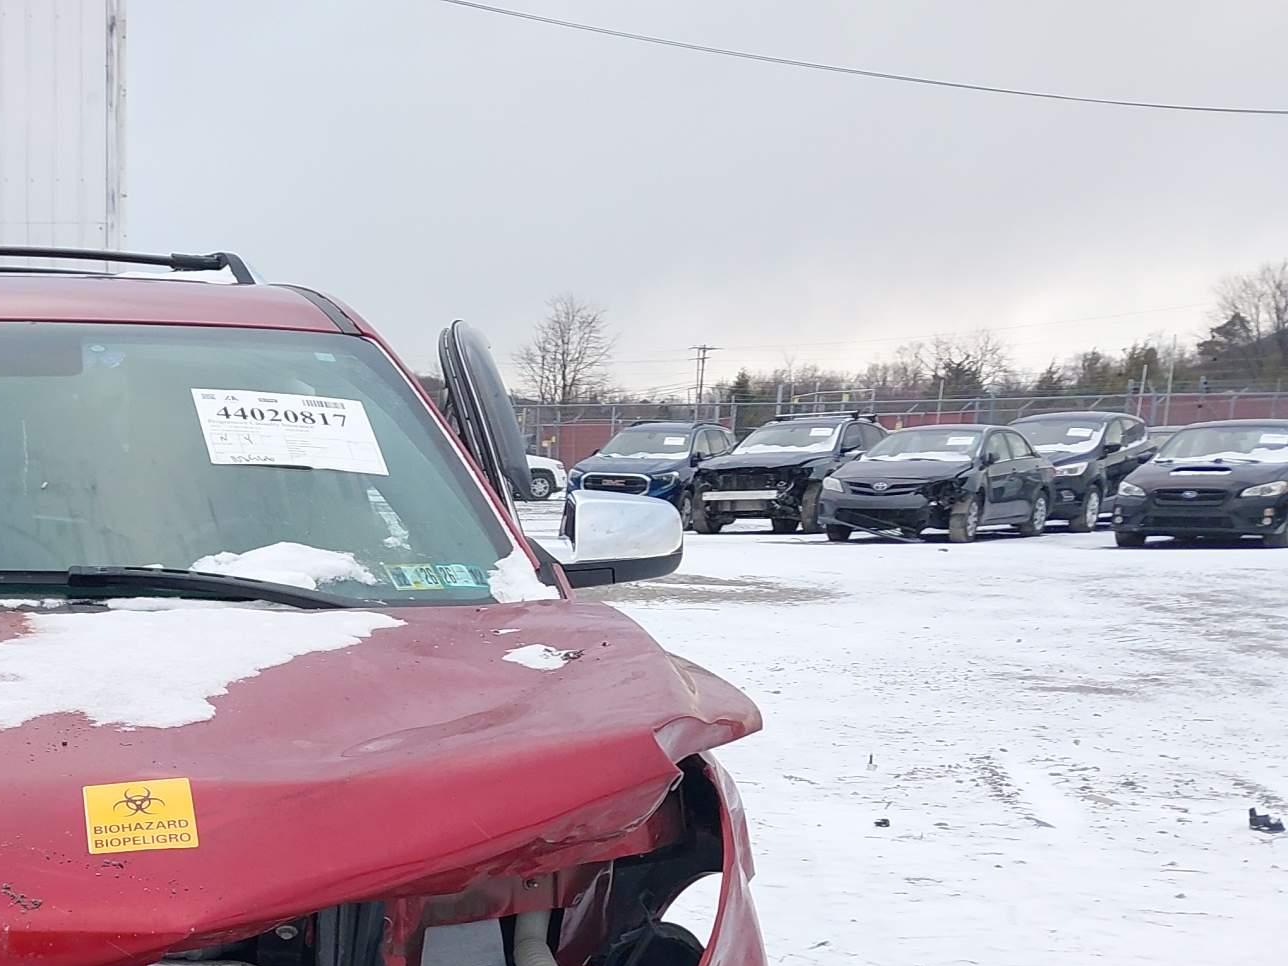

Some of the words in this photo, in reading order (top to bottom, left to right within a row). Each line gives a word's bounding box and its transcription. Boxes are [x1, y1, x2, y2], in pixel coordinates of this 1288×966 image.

[216, 405, 347, 427] 44020817
[439, 567, 456, 584] 26
[93, 819, 189, 835] BIOHAZARD
[94, 832, 191, 849] BIOPELIGRO
